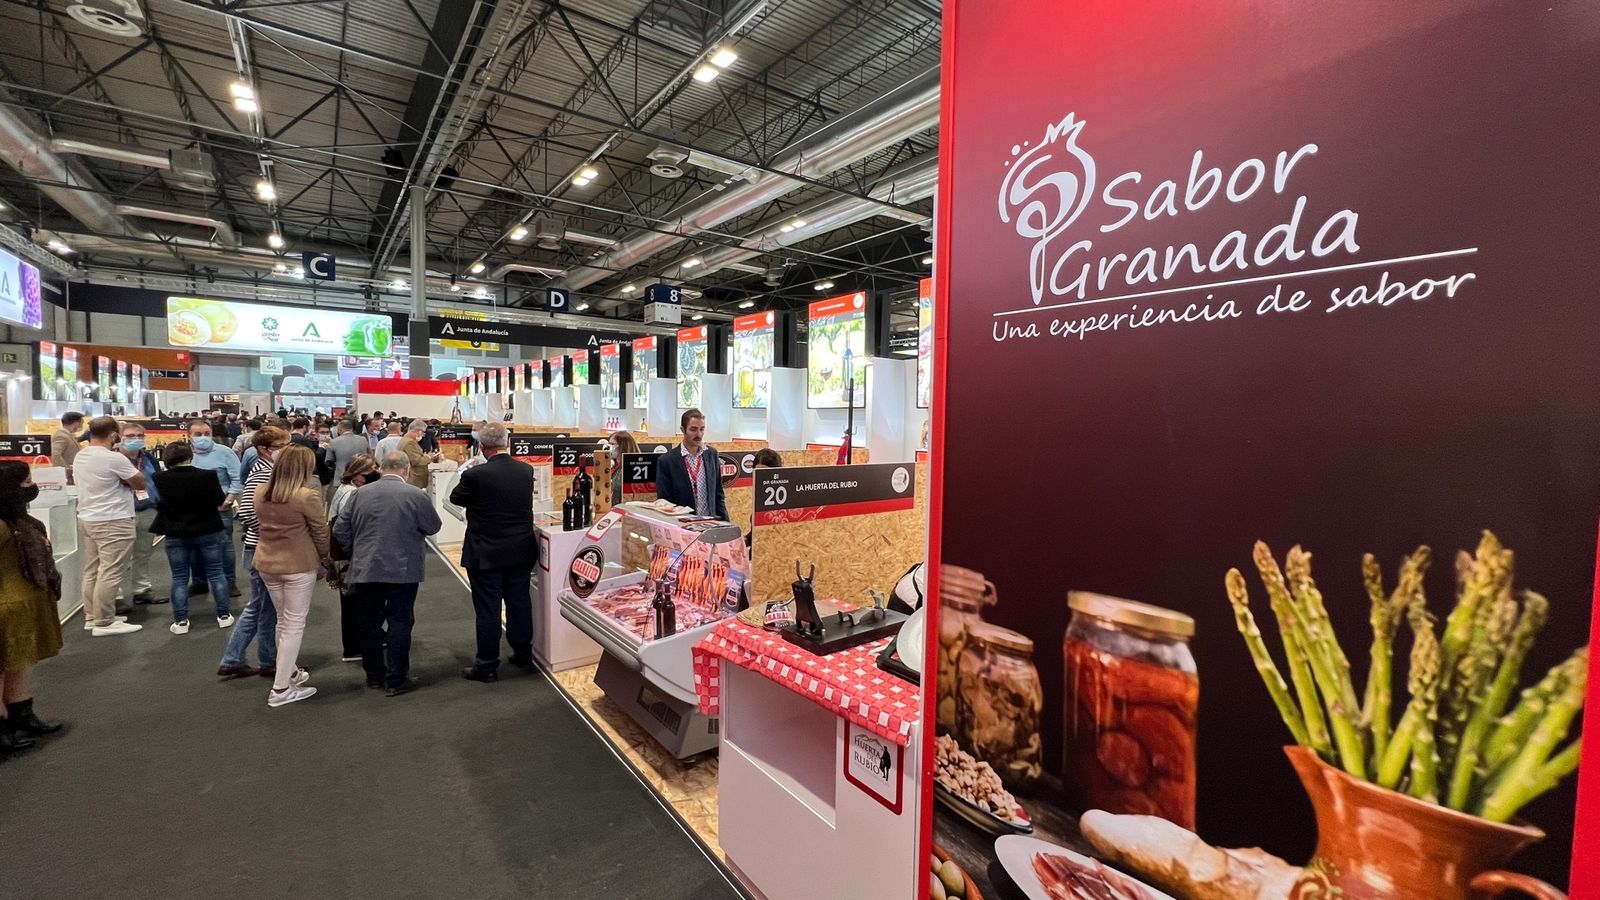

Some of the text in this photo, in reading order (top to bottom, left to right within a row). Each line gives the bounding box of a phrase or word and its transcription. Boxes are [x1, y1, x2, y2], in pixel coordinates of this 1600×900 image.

[1099, 143, 1318, 233] Sabor
[1049, 195, 1361, 299] Granada
[310, 256, 328, 276] C
[551, 291, 565, 307] D
[670, 289, 679, 302] 8
[993, 271, 1476, 342] Una experiencia de sabor
[481, 328, 509, 336] Andalucía
[22, 444, 41, 454] 01
[516, 445, 529, 455] 23
[560, 453, 576, 465] 22
[633, 466, 648, 480] 21
[796, 480, 858, 492] LA HUERTA DEL RUBIO
[764, 486, 787, 506] 20
[854, 735, 880, 759] HUERTA
[854, 751, 880, 774] RUBIO
